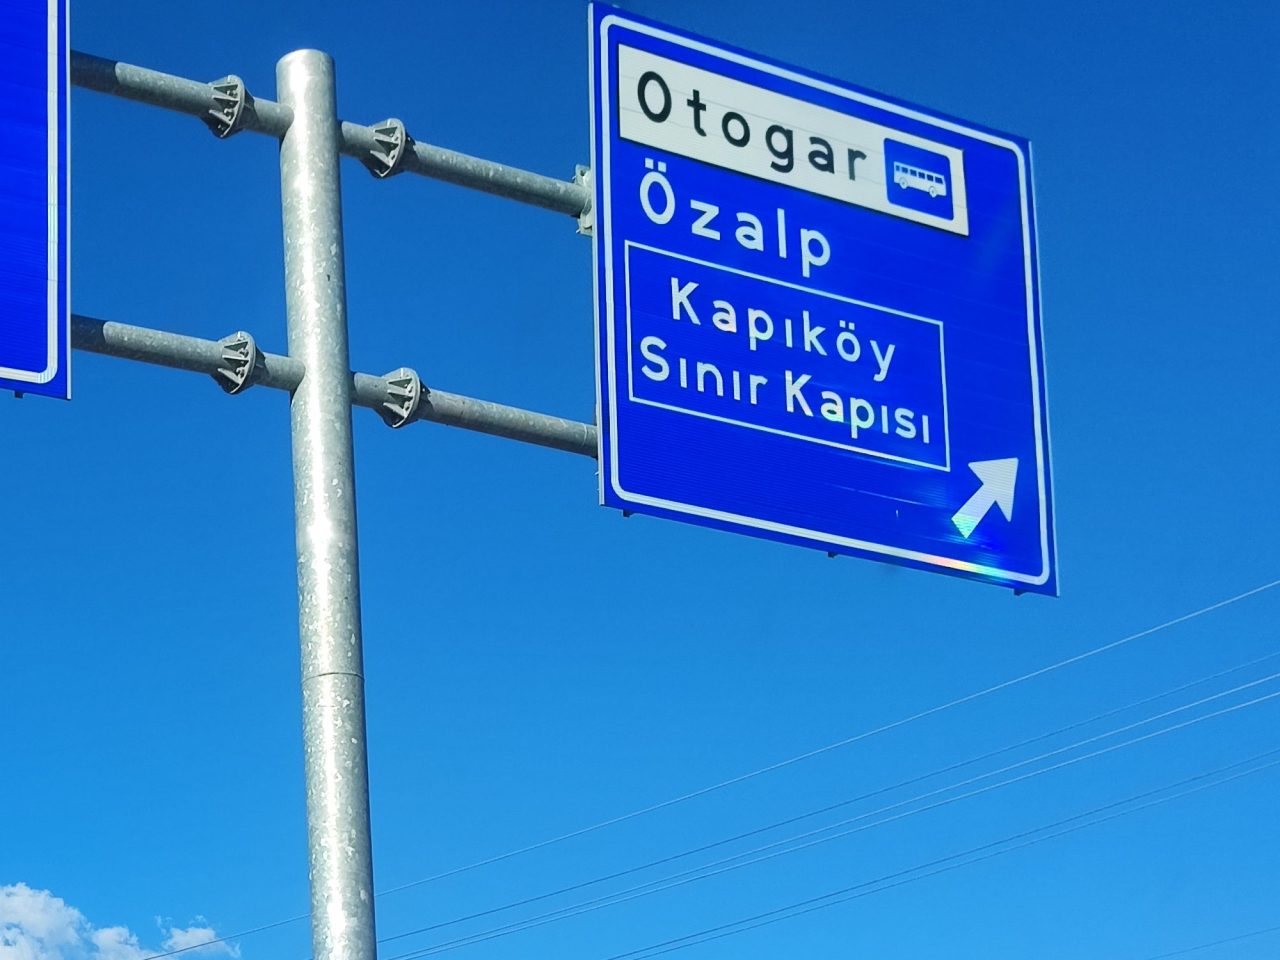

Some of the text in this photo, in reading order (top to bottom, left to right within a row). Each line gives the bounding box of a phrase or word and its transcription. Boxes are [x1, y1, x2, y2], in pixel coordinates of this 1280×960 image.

[637, 71, 867, 181] Otogar
[639, 157, 831, 278] Özalp
[671, 277, 896, 382] Kapıköy
[640, 336, 930, 444] Sınır Kapısı
